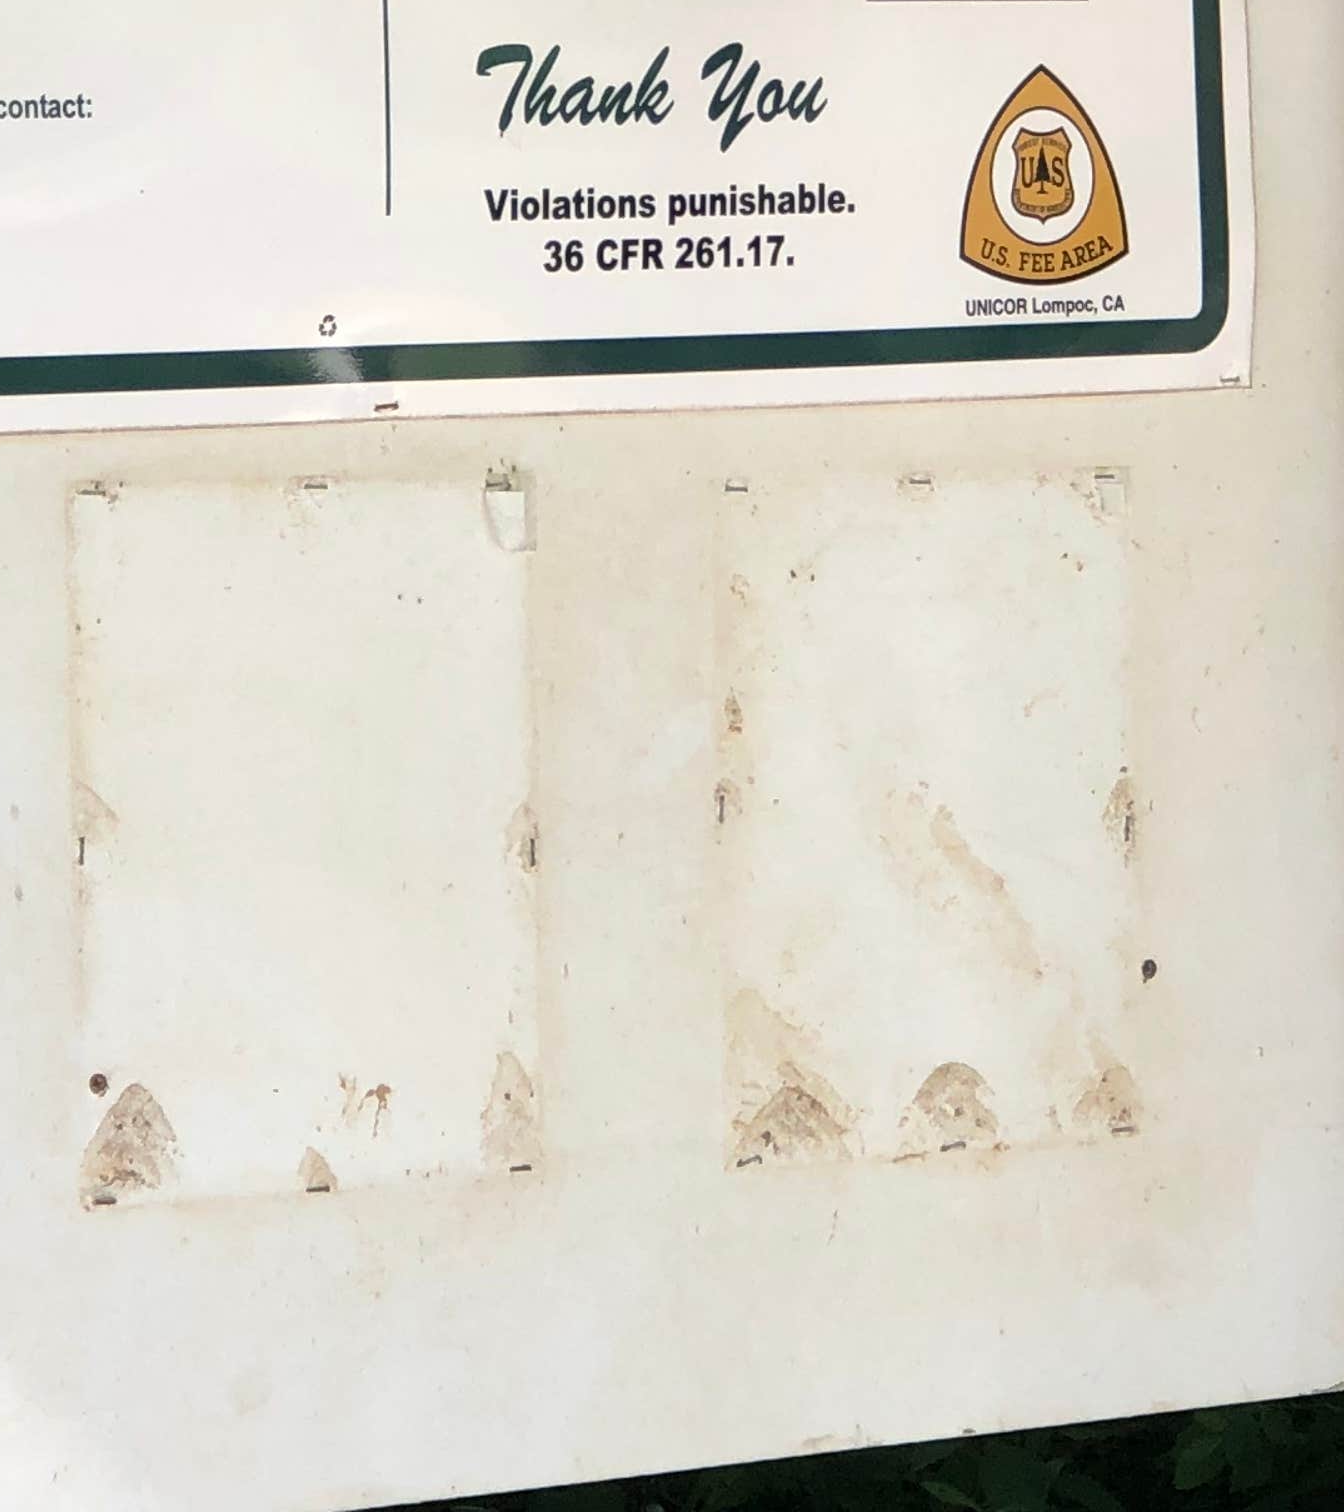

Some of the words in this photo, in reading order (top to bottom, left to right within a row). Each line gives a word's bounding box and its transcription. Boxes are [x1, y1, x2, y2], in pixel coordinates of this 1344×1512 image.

[475, 43, 675, 136] Thank
[700, 41, 828, 154] You
[484, 188, 656, 223] Violations
[668, 182, 856, 227] punishable.
[542, 239, 584, 274] 36
[596, 237, 665, 272] CFR
[674, 234, 795, 271] 261.17.
[980, 237, 1011, 269] U.S.
[1018, 251, 1056, 274] FEE
[1059, 234, 1114, 272] AREA
[965, 297, 1028, 318] UNICOR
[1032, 295, 1099, 318] Lompoc,
[1102, 294, 1126, 313] CA
